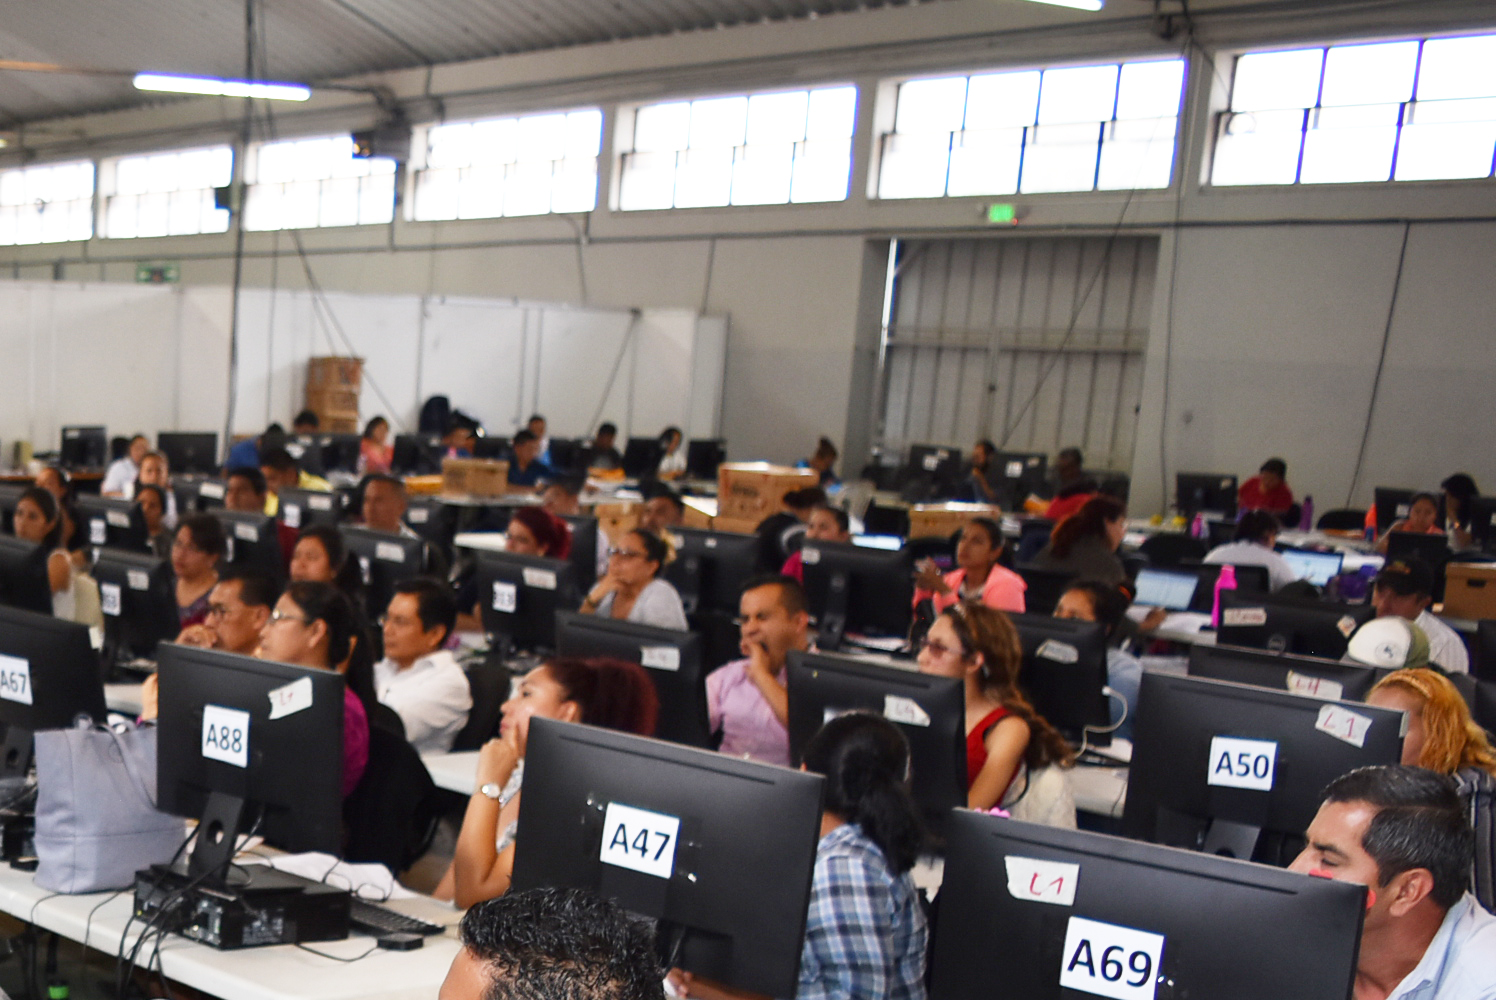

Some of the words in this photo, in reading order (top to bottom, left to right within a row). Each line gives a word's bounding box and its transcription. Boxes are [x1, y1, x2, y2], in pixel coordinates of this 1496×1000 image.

[0, 669, 27, 695] A67
[206, 723, 243, 754] A88
[1215, 751, 1270, 779] A50
[609, 822, 671, 862] A47
[1029, 871, 1064, 896] L1
[1067, 938, 1153, 988] A69
